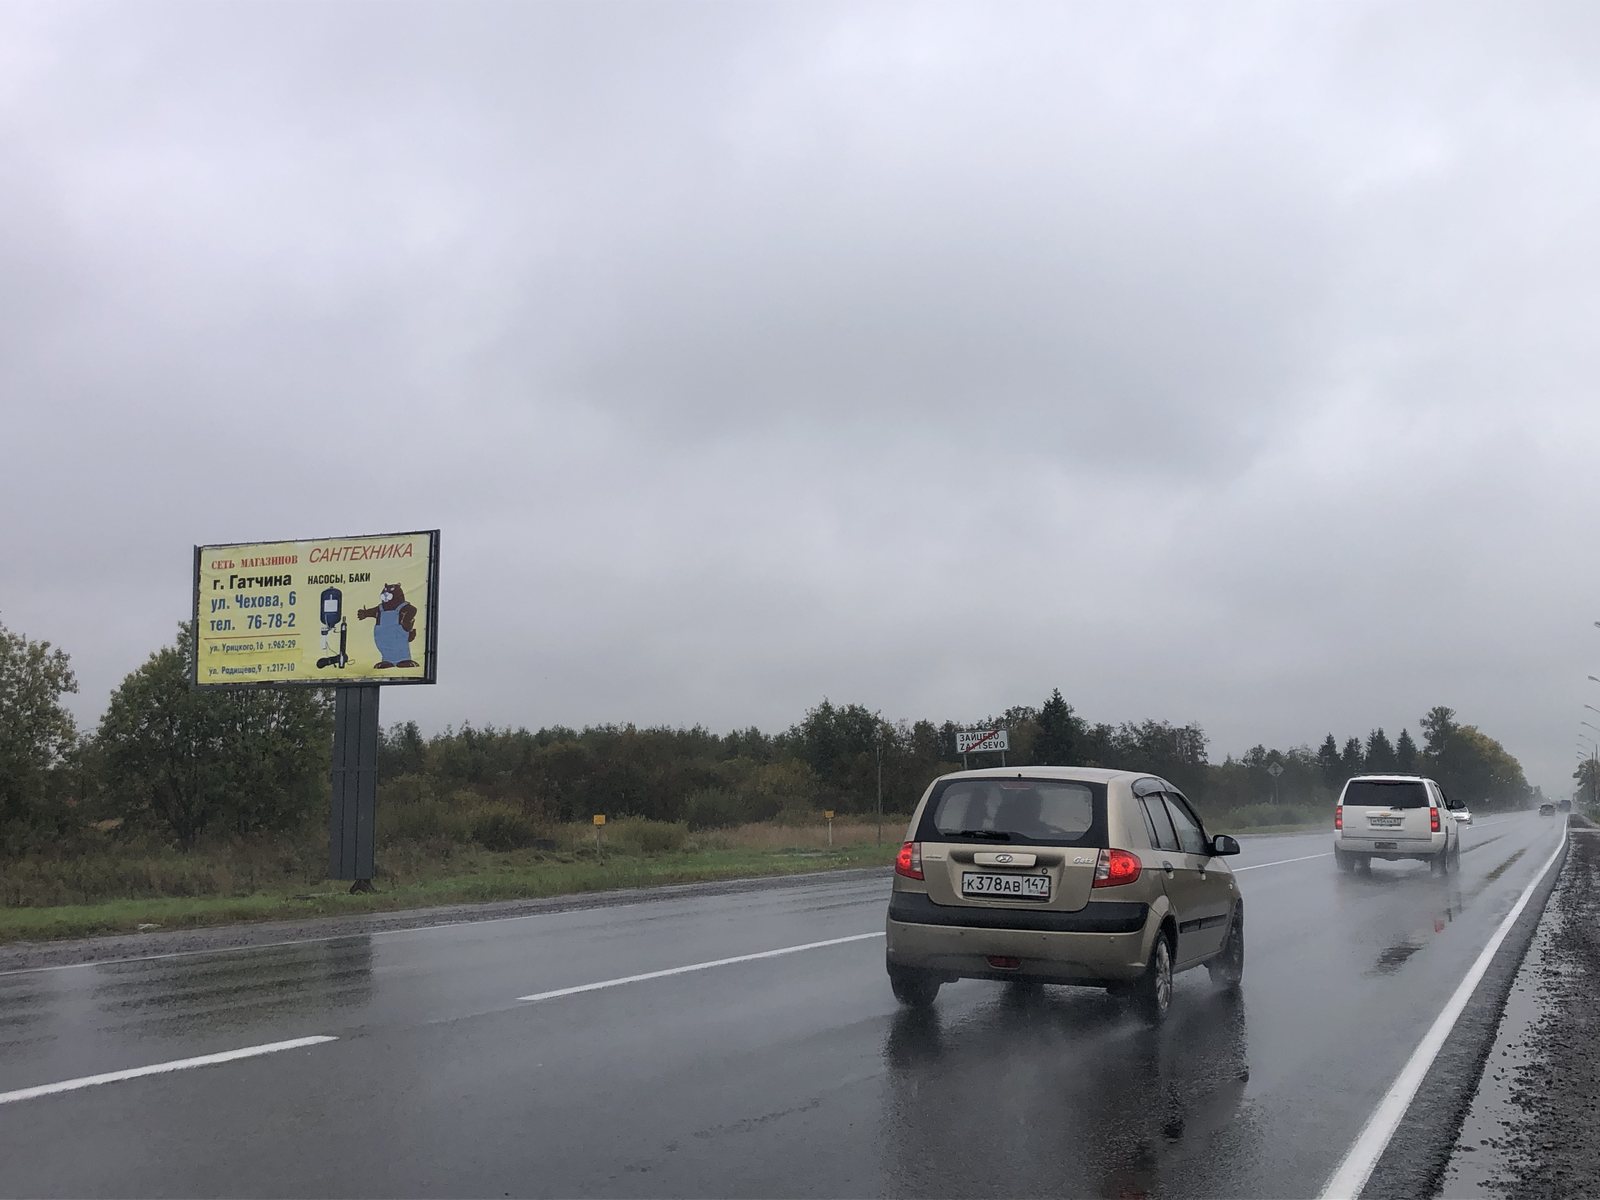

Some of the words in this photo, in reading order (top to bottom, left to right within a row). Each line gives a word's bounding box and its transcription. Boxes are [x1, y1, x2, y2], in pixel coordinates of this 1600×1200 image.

[309, 543, 414, 563] САНТЕХНИКА
[211, 559, 236, 570] СЕТЬ
[240, 555, 298, 568] МАГАЗИНОВ
[213, 579, 224, 590] г.
[230, 575, 292, 589] Гатчина
[307, 574, 346, 585] НАСОСЫ,
[348, 572, 371, 583] БАКИ
[211, 598, 230, 613] ул.
[235, 594, 284, 609] Чехова,
[289, 591, 297, 606] 6
[210, 619, 236, 631] тел.
[247, 613, 296, 629] 76-78-2
[209, 644, 220, 654] ул.
